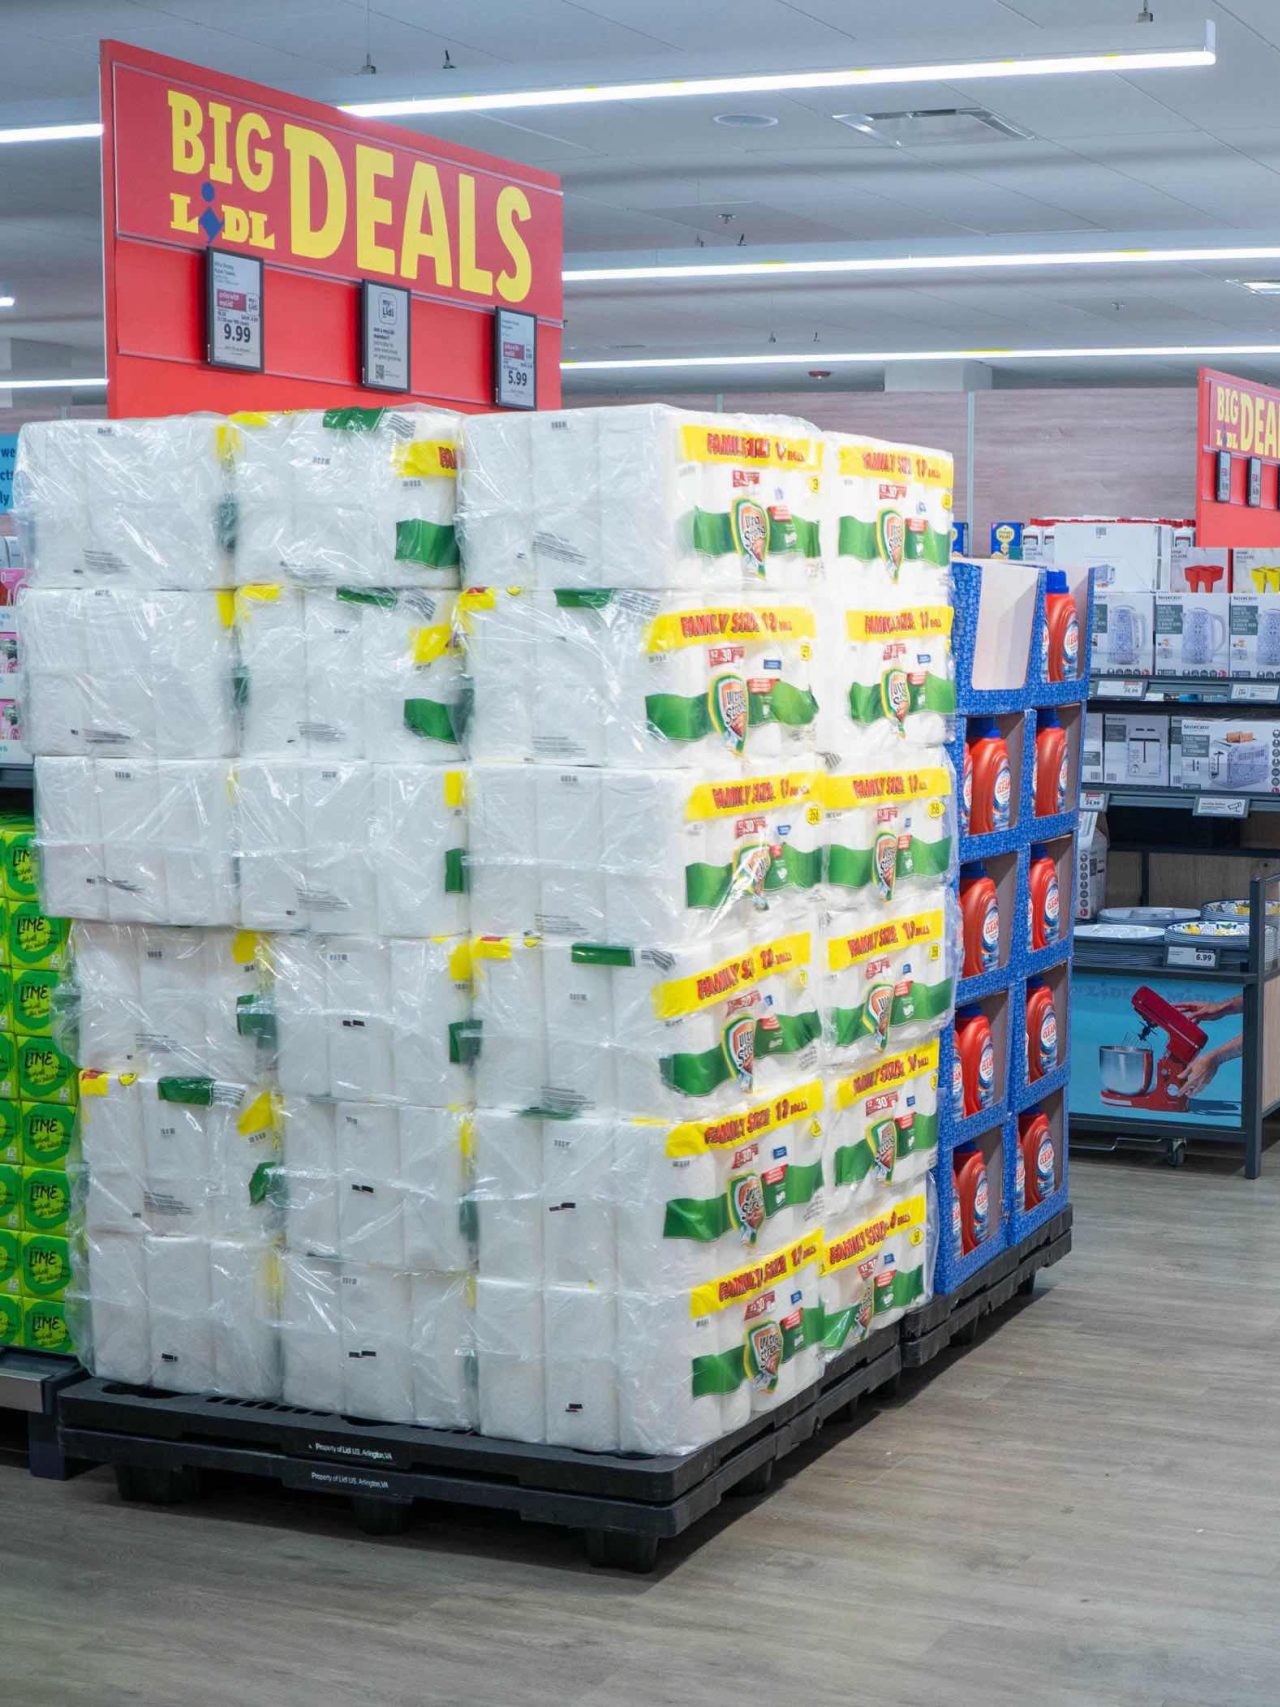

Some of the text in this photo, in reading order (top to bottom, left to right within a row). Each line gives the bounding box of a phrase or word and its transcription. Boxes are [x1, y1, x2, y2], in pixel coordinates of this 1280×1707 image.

[167, 90, 532, 303] BIG DEALS
[224, 323, 251, 343] 9.99
[508, 370, 528, 386] 5.99
[1217, 386, 1239, 425] BIG
[681, 613, 729, 638] FAMILY
[17, 917, 45, 936] LIME
[1196, 953, 1212, 961] 6.99
[21, 985, 48, 1003] LIME
[1042, 1026, 1058, 1040] CLEAN
[25, 1050, 54, 1070] LIME
[29, 1118, 58, 1136] LIME
[704, 1118, 746, 1144] FAMILY
[790, 1103, 808, 1115] ROLLS
[1038, 1153, 1054, 1169] CLEAN
[30, 1185, 59, 1200] LIME
[829, 1234, 866, 1265] FAMILY
[29, 1251, 57, 1268] LIME
[718, 1267, 763, 1302] FAMILY
[32, 1316, 60, 1333] LIME
[315, 1442, 336, 1452] Property
[311, 1472, 332, 1482] Property
